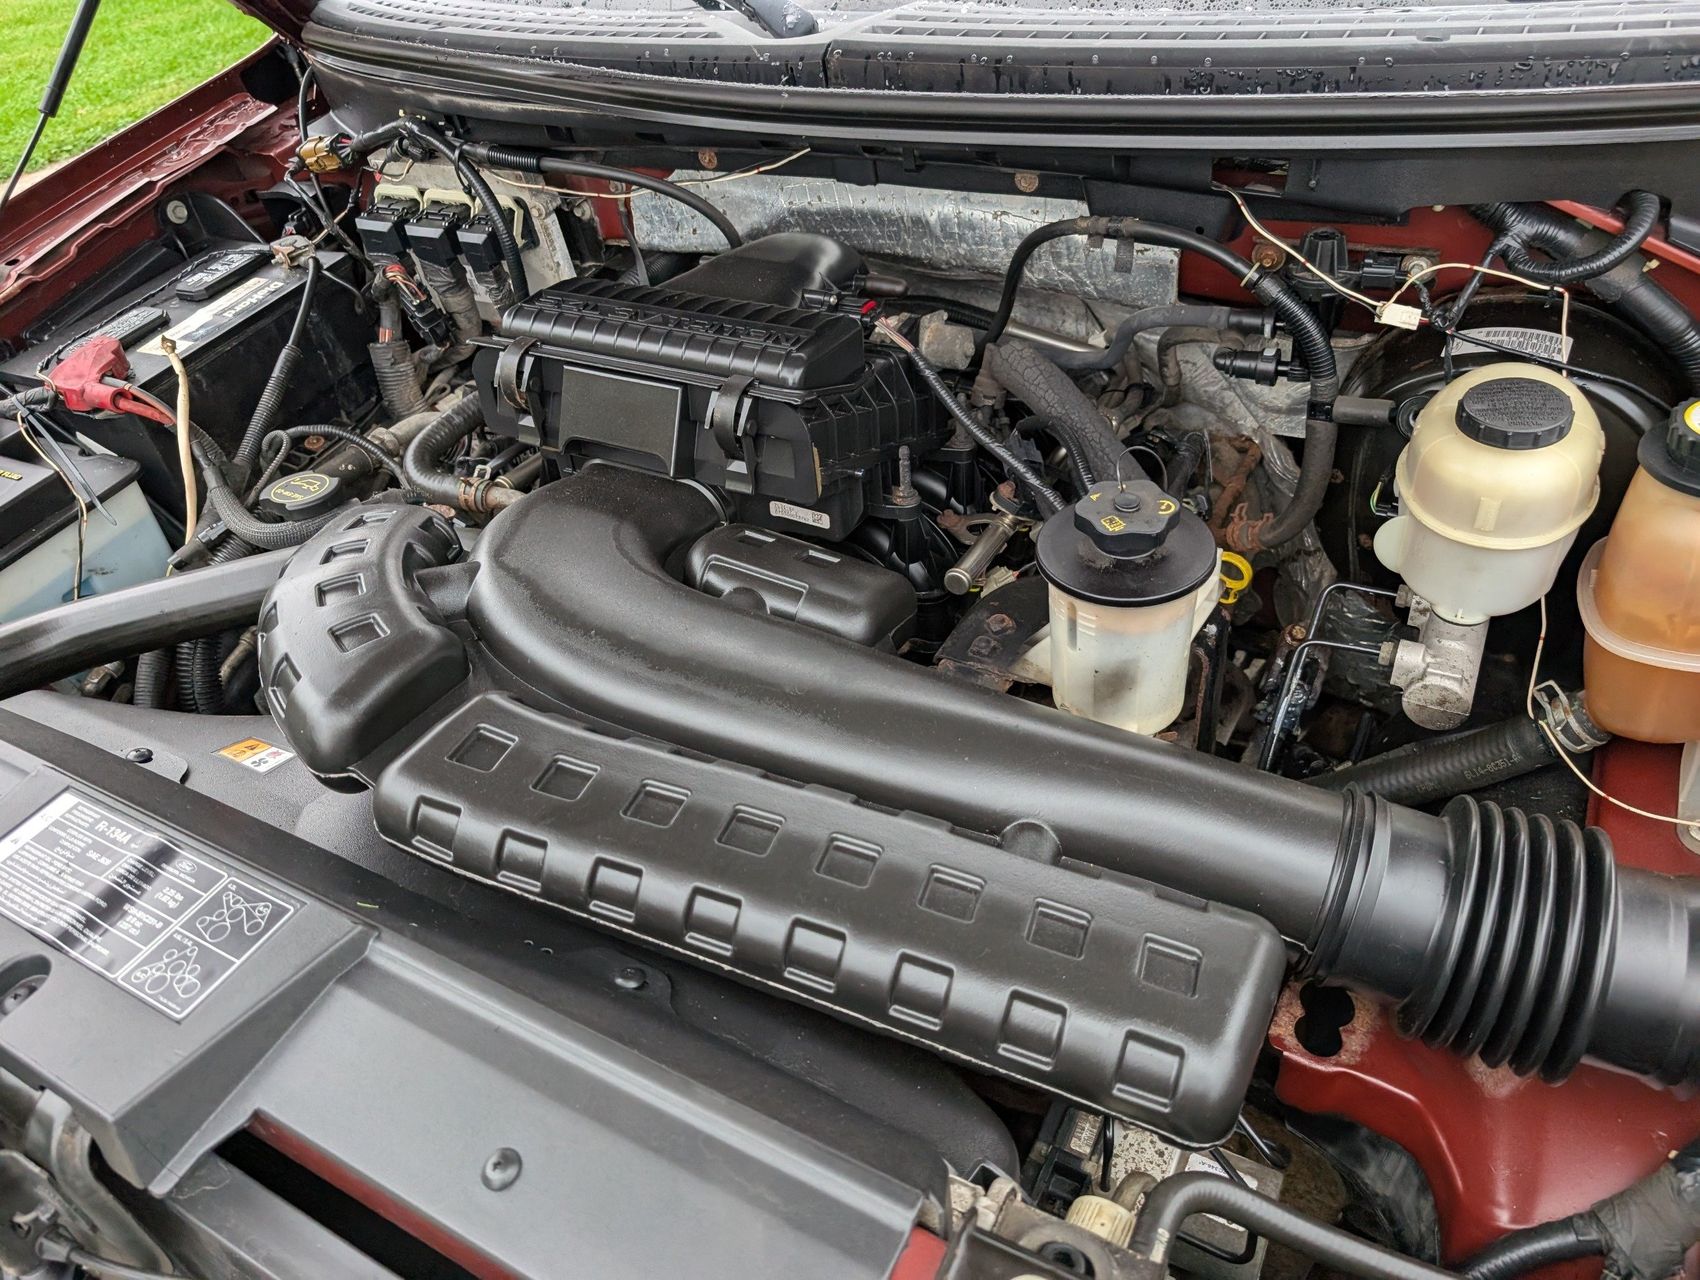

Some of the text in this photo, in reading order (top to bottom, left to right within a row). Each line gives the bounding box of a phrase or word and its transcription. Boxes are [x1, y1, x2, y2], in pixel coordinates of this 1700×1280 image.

[223, 280, 286, 319] DieHard
[664, 314, 800, 347] TRITON
[95, 820, 132, 845] R-134A
